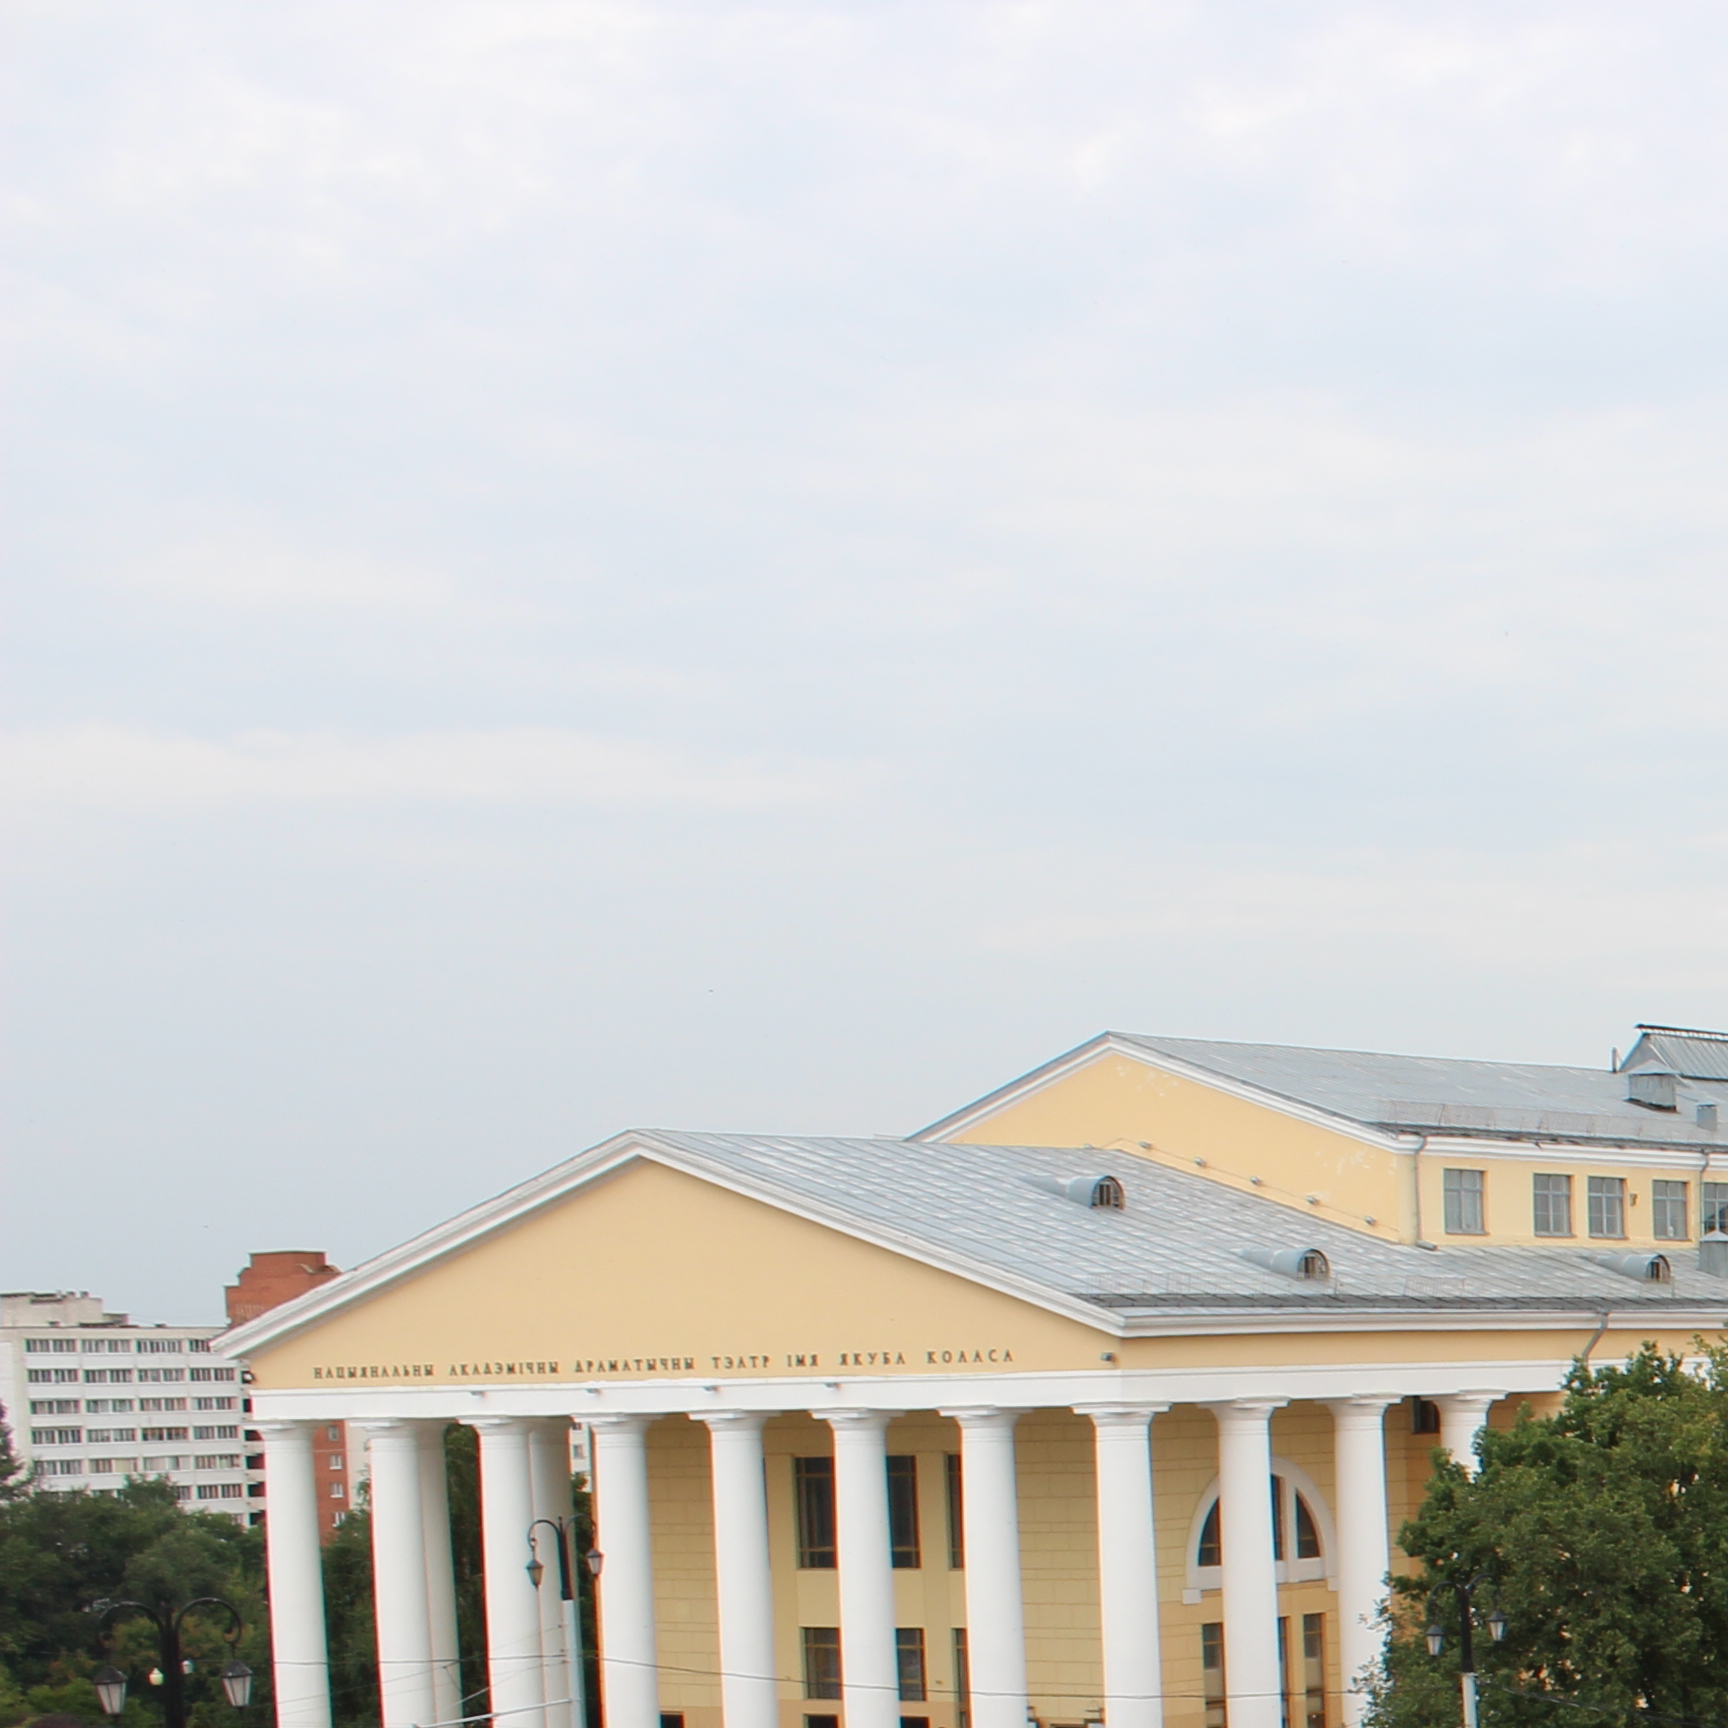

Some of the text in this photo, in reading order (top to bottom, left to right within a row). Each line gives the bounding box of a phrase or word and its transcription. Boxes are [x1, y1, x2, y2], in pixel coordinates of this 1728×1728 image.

[313, 1348, 1014, 1379] НАЦЫЯНАЛЬНЫ АКАДЭМІЧНЫ ДРАМАТЫЧНЫ ТЭАТР ІМЯ ЯКУБА КОЛАСА
